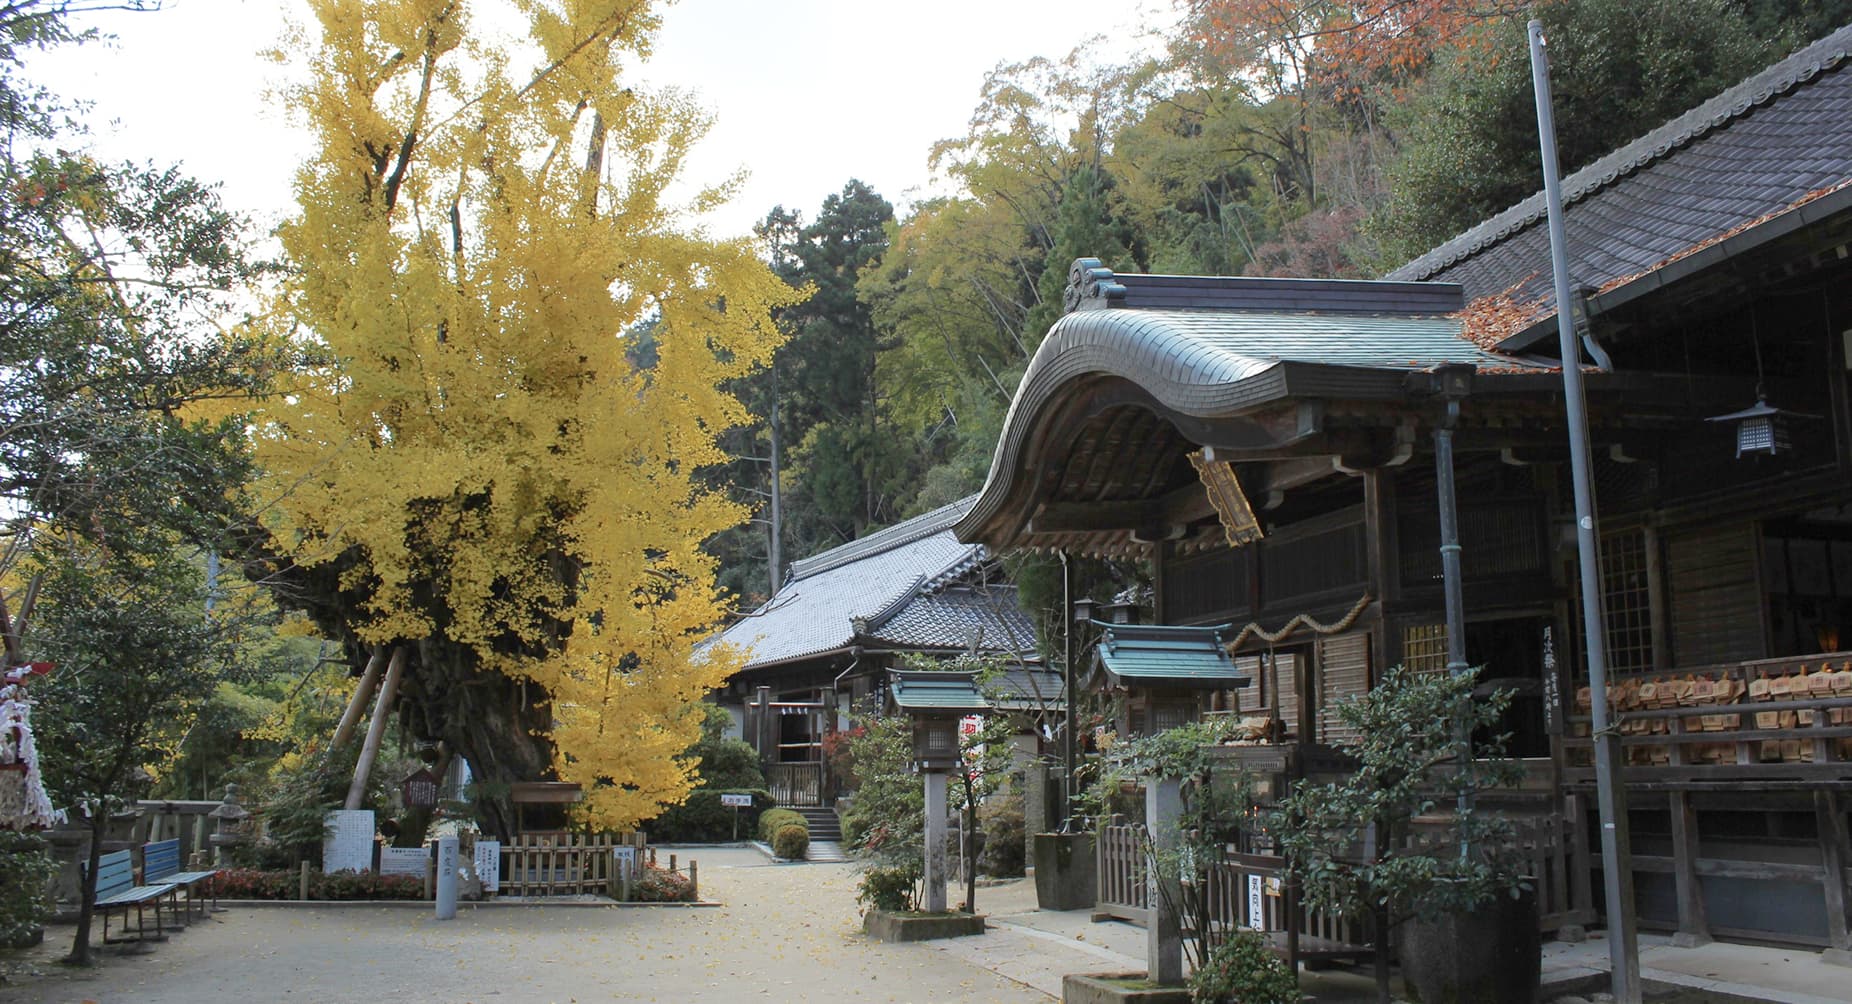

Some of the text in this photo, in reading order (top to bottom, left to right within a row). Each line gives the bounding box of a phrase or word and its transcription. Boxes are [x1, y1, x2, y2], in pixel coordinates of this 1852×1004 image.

[1543, 625, 1555, 669] 月次祭
[444, 846, 453, 876] 百度石
